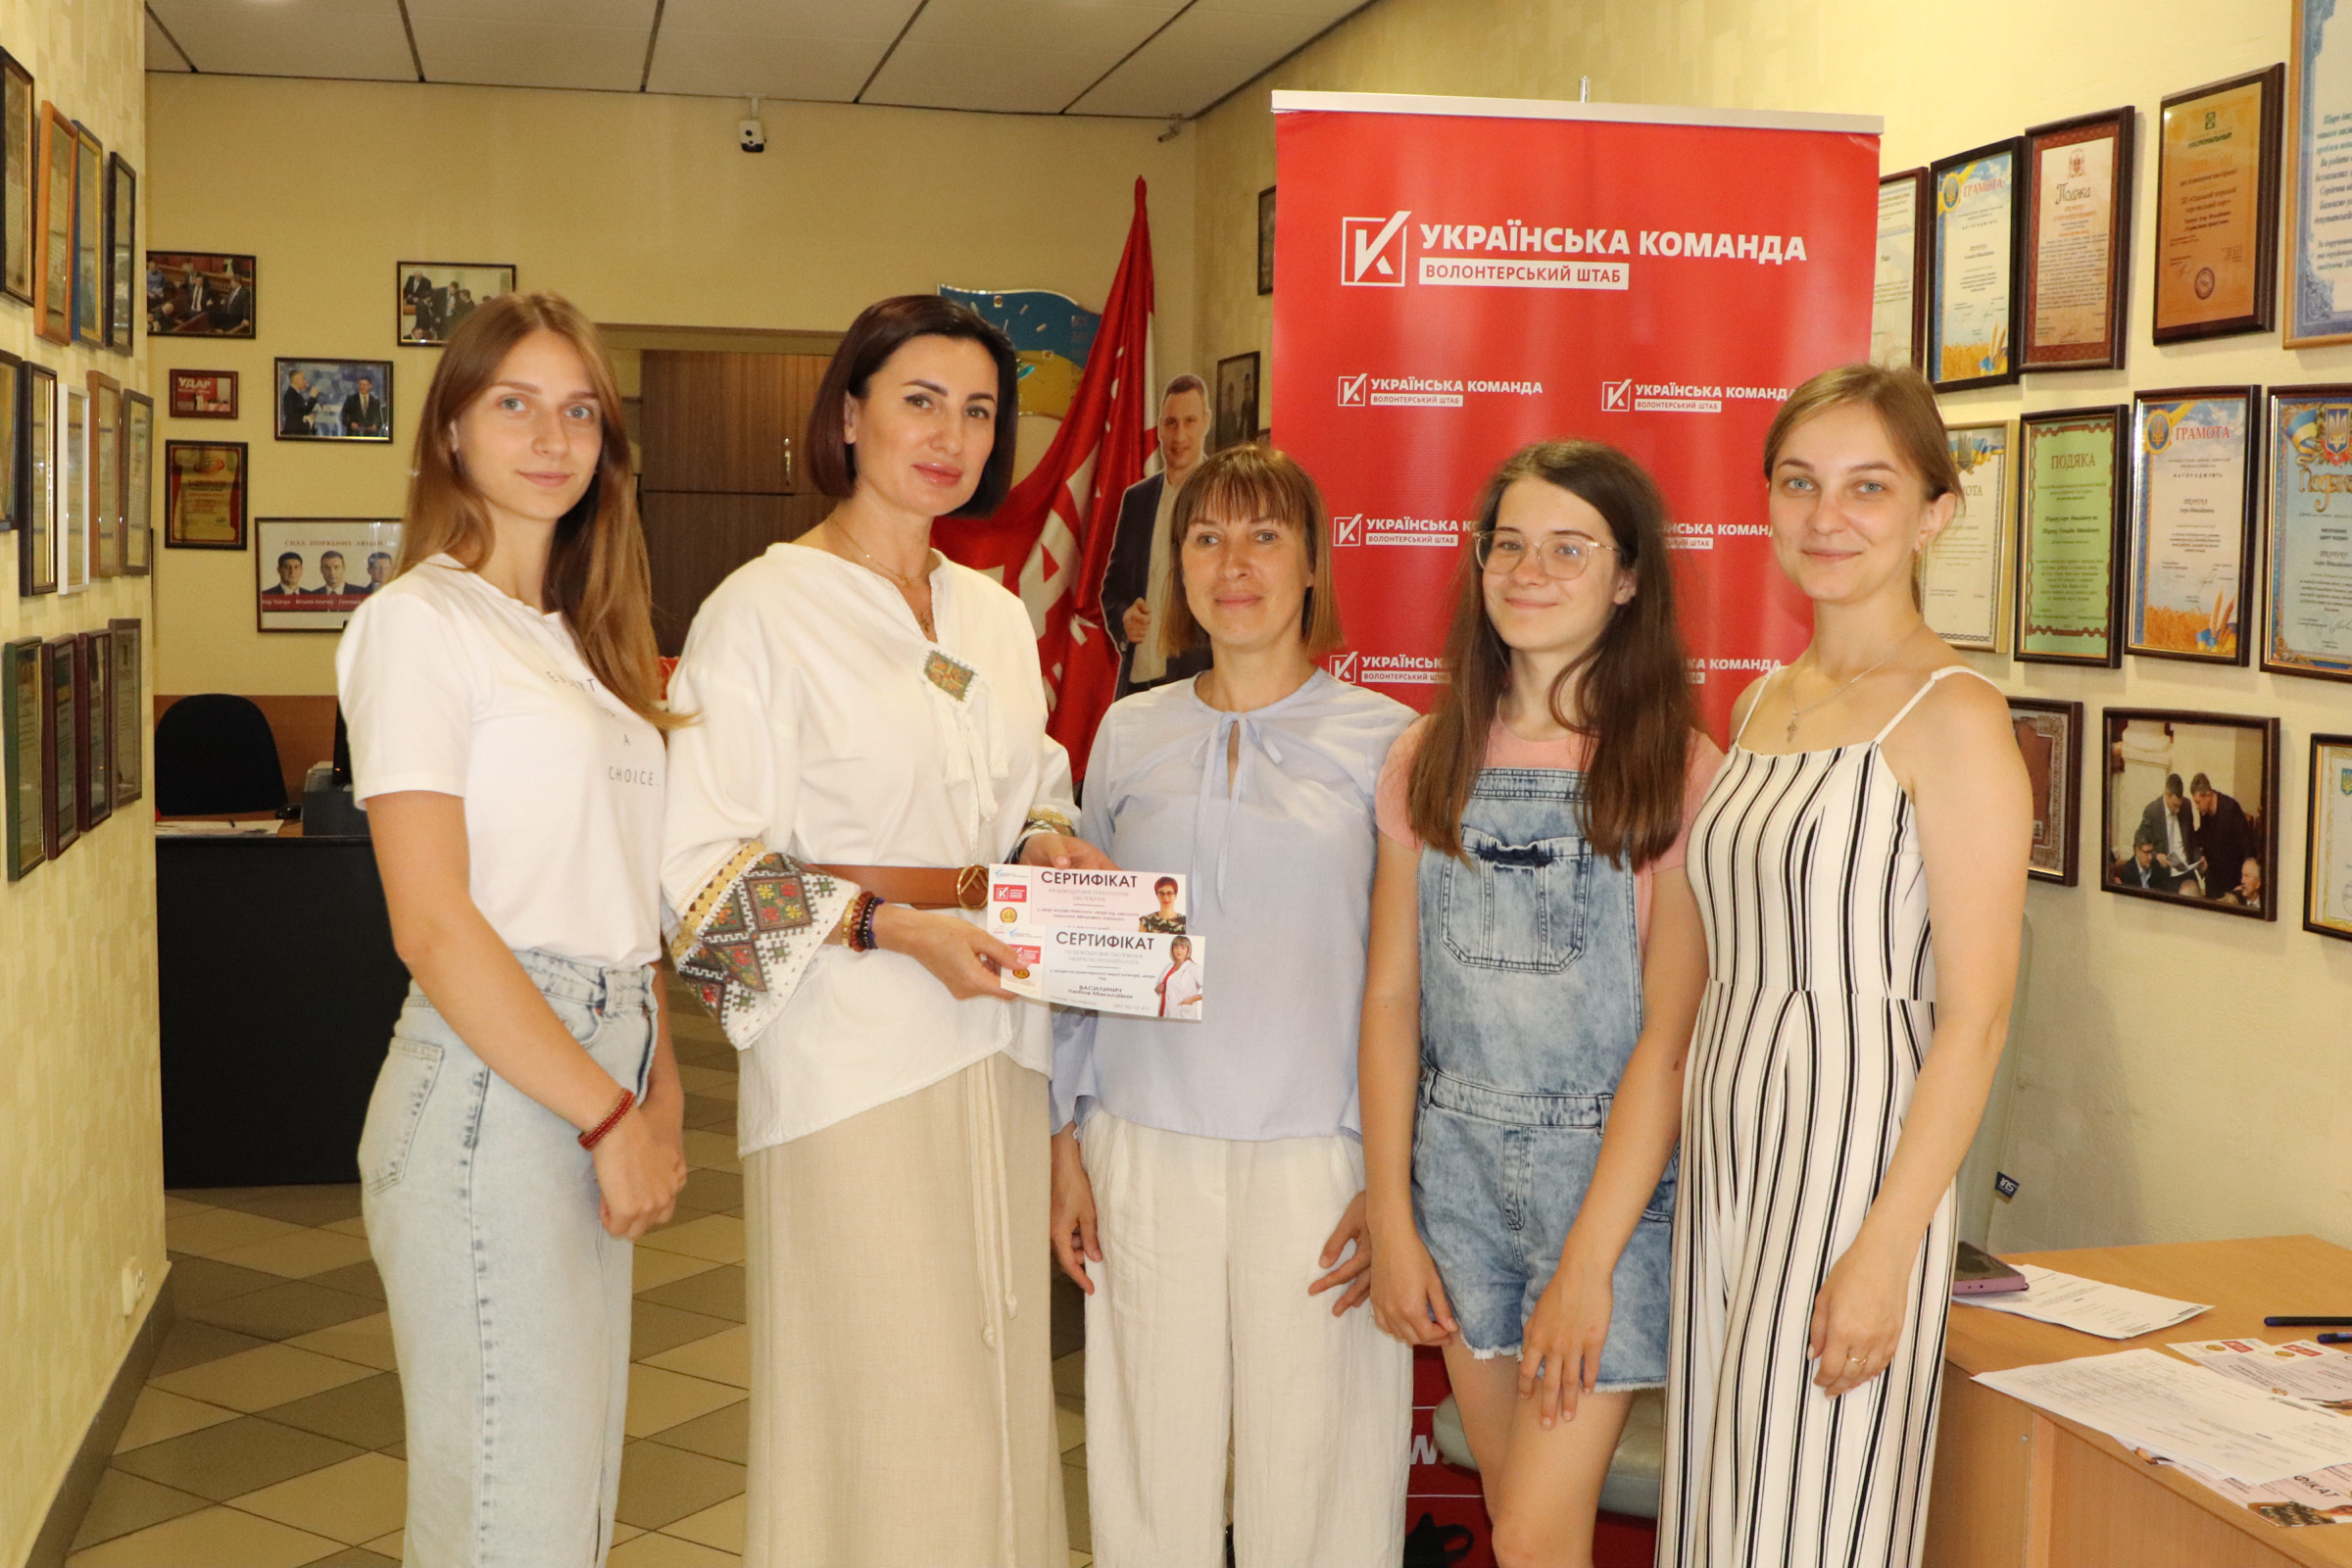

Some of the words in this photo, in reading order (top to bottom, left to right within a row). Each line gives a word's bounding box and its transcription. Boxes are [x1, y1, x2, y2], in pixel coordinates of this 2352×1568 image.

[1963, 178, 2003, 198] ГРАМОТА
[1419, 219, 1631, 255] УКРАЇНСЬКА
[1640, 230, 1808, 266] КОМАНДА
[1425, 264, 1571, 283] ВОЛОНТЕРСЬКИЙ
[1577, 269, 1622, 284] ШТАБ
[178, 376, 211, 389] УДАР
[1371, 376, 1464, 392] УКРАЇНСЬКА
[1468, 380, 1544, 395] КОМАНДА
[1635, 382, 1723, 398] УКРАЇНСЬКА
[1637, 401, 1697, 410] ВОЛОНТЕРСЬКИЙ
[2176, 425, 2230, 440] ГРАМОТА
[2051, 454, 2096, 470] ПОДЯКА
[1366, 516, 1459, 532] УКРАЇНСЬКА
[1718, 524, 1773, 537] КОМАН
[1362, 655, 1444, 668] УКРАЇНСЬК
[1709, 659, 1782, 672] КОМАНДА
[1363, 672, 1428, 681] ВОЛОНТЕРСЬКИЙ
[1041, 870, 1138, 888] СЕРТИФІКАТ
[1056, 931, 1154, 951] СЕРТИФІКАТ
[2294, 1475, 2341, 1498] ФІКАТ
